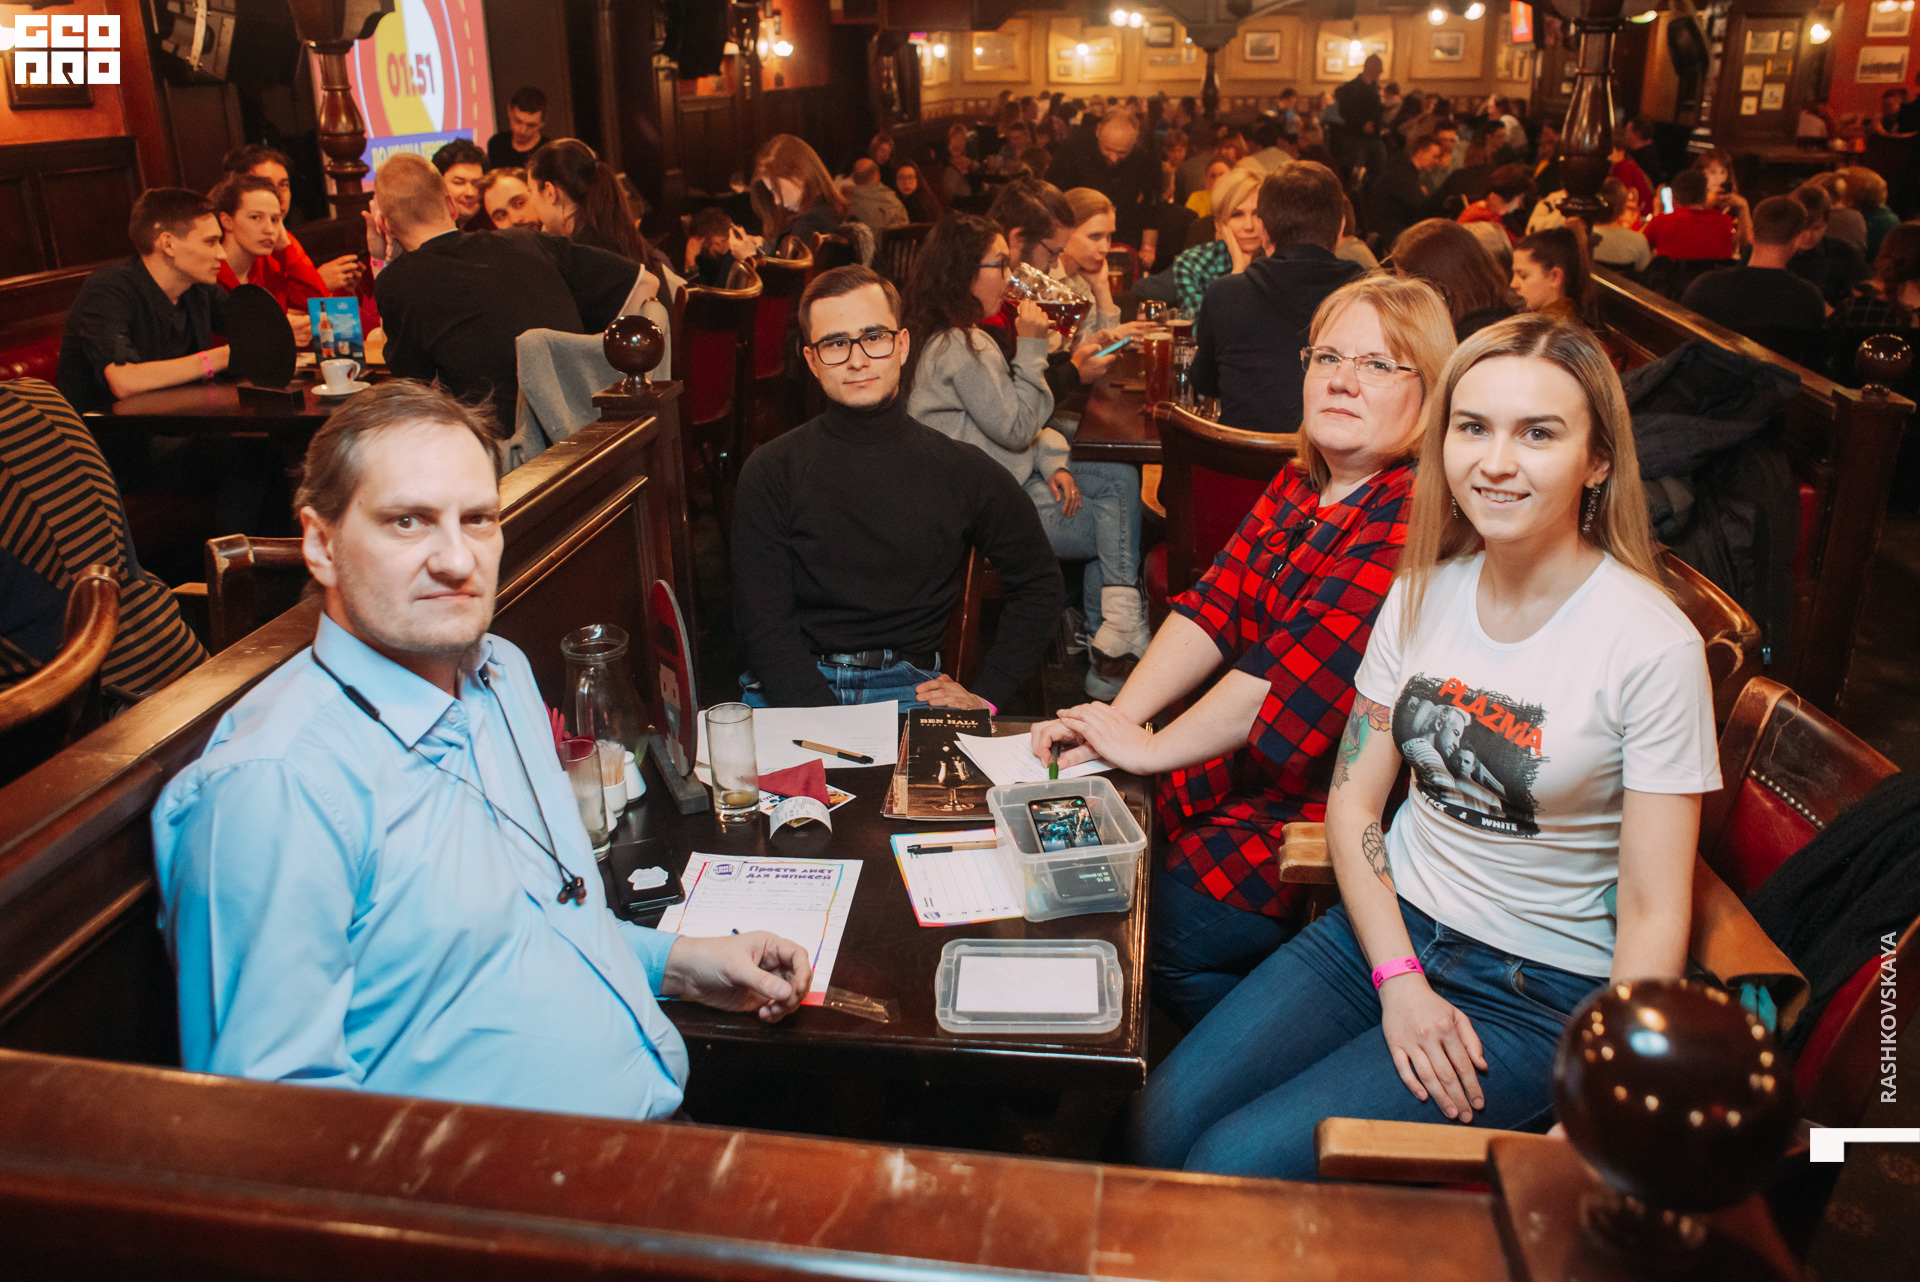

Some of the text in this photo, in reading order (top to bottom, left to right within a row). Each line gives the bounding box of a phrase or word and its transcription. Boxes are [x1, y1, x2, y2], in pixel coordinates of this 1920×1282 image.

[387, 52, 435, 98] 01:51
[1438, 677, 1542, 757] PLAZMA
[1459, 811, 1468, 820] &
[1481, 817, 1518, 831] WHITE
